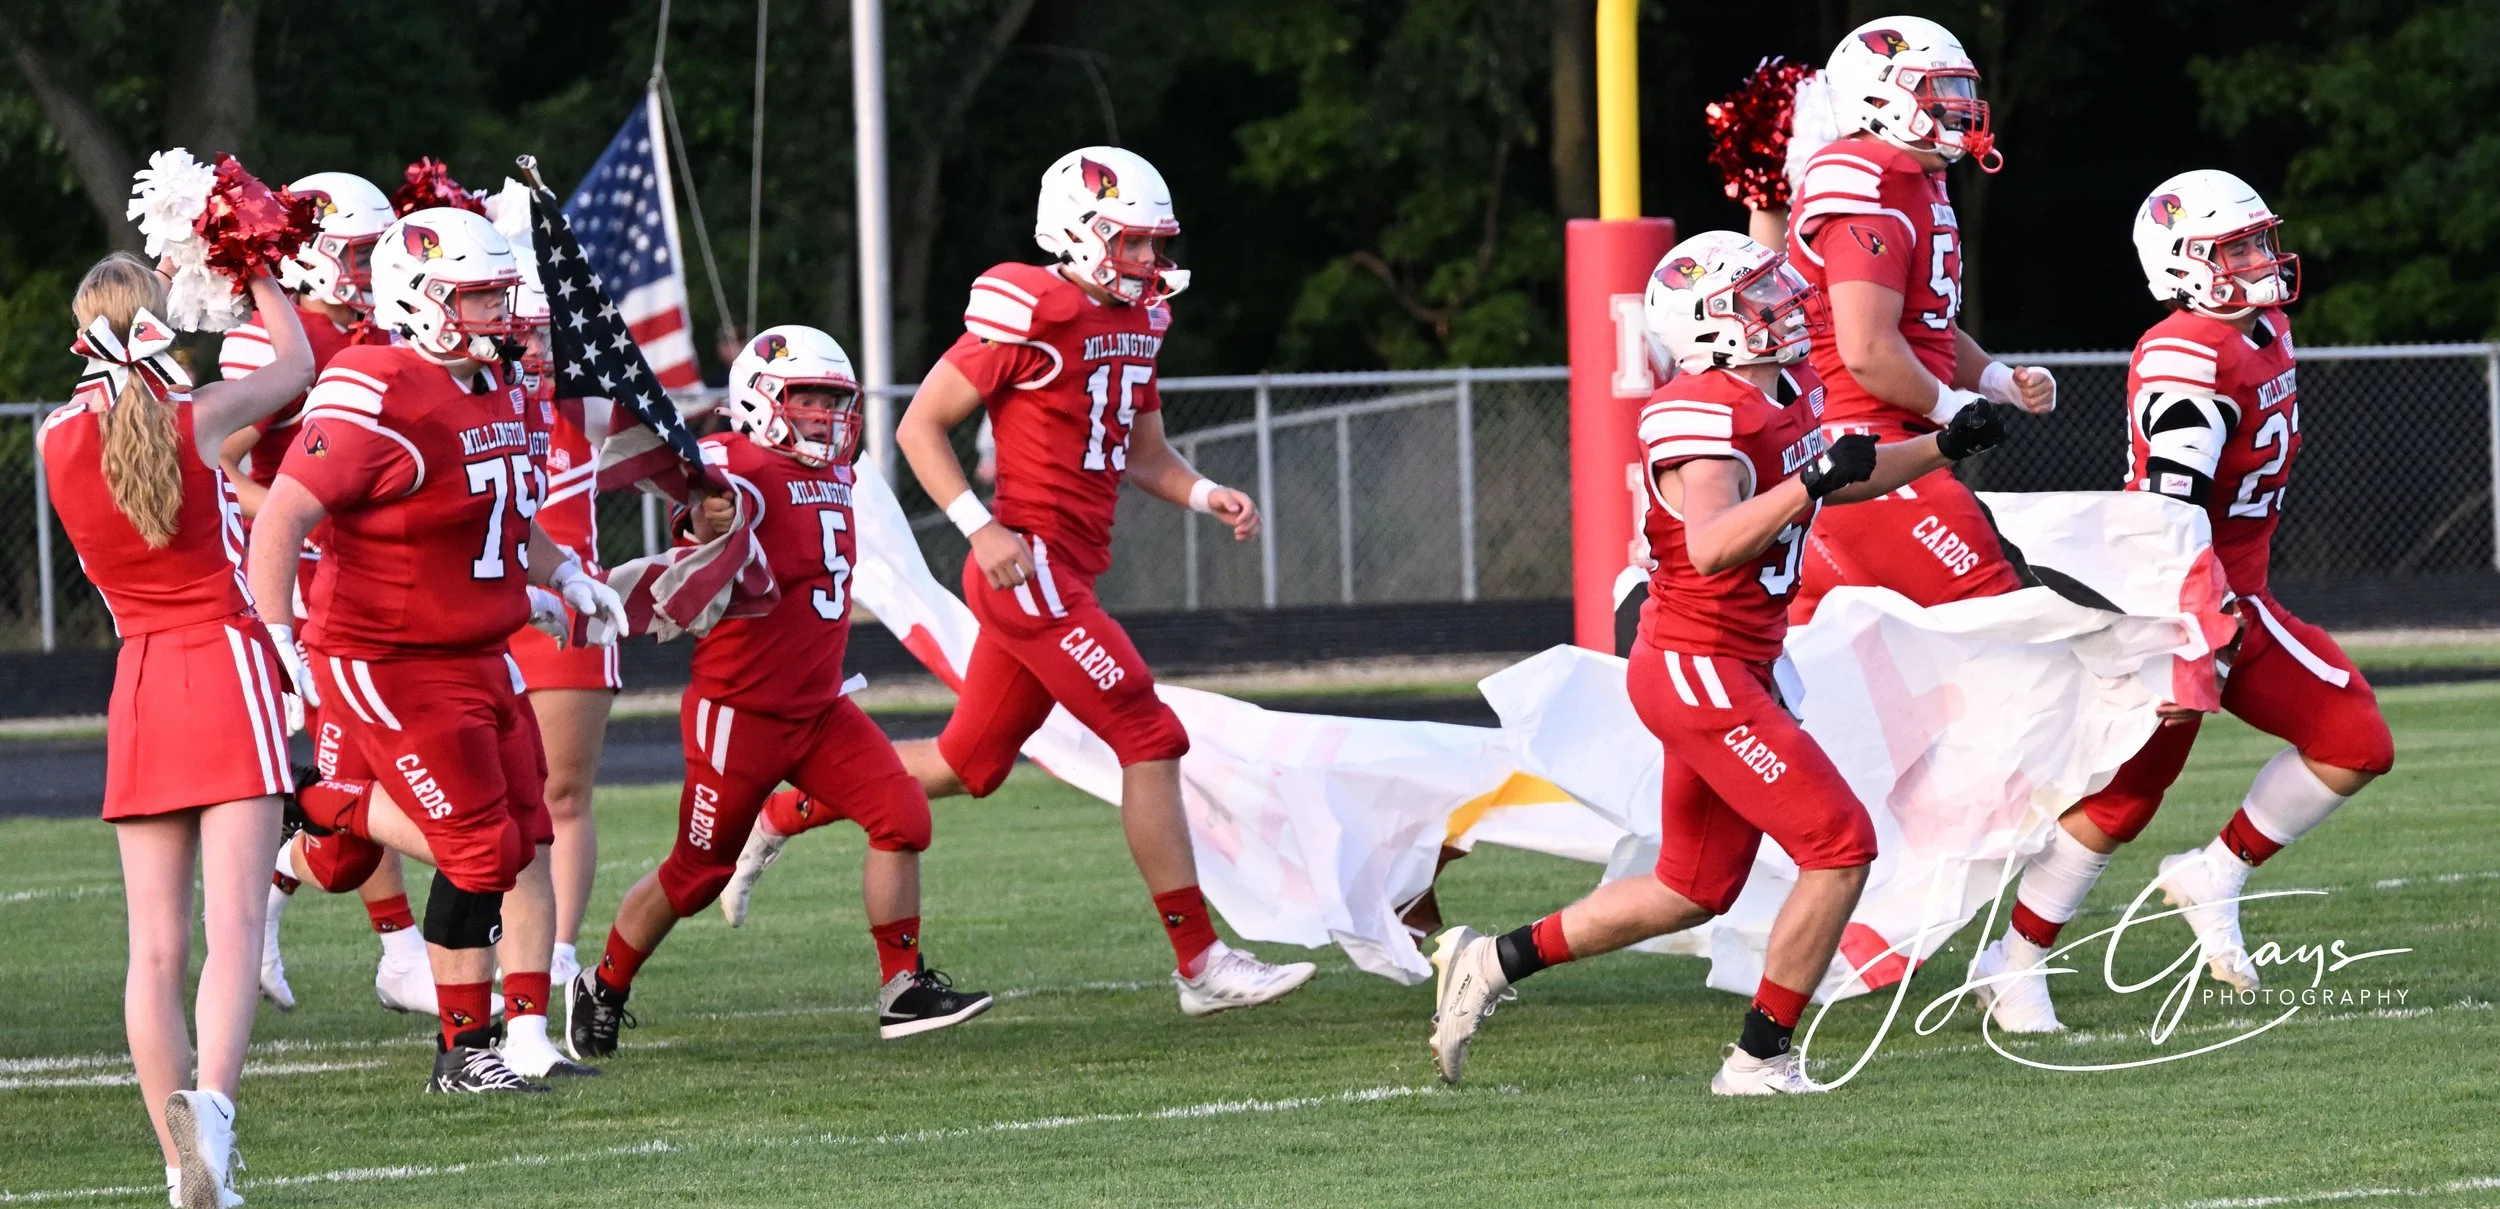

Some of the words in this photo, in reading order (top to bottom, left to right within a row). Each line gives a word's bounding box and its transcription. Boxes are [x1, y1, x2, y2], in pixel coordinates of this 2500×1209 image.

[1083, 333, 1163, 360] MILLINGTON
[1083, 364, 1153, 471] 15
[465, 454, 537, 579] 75
[1912, 514, 1980, 577] CARDS
[812, 509, 851, 620] 5
[1059, 626, 1125, 691] CARDS
[317, 722, 342, 781] CARD
[1723, 724, 1787, 784] CARDS
[395, 753, 453, 820] CARDS
[688, 783, 719, 851] CARDS
